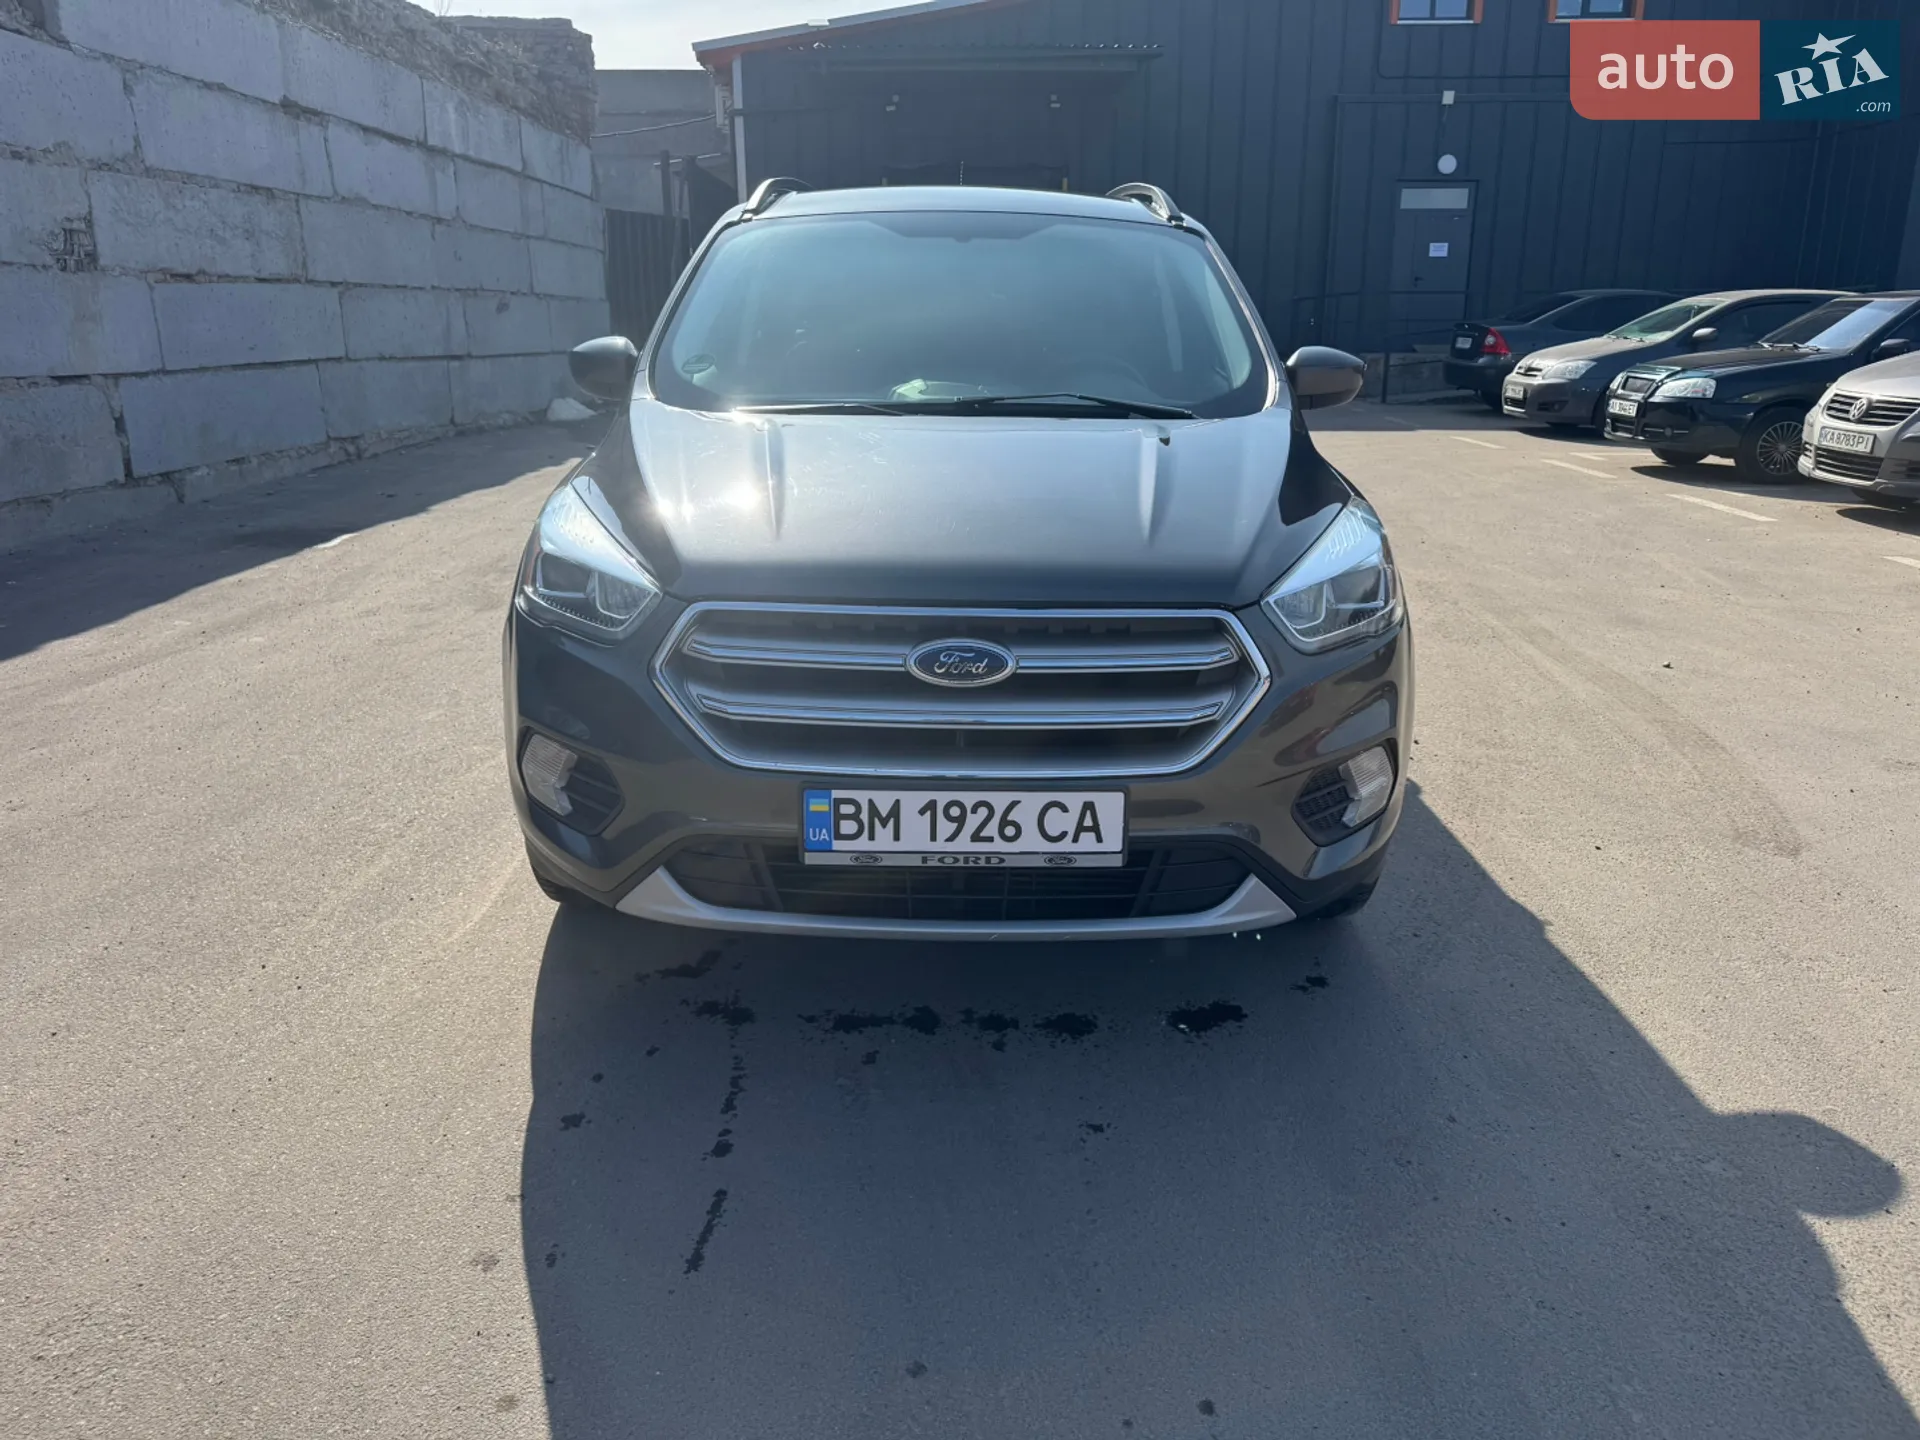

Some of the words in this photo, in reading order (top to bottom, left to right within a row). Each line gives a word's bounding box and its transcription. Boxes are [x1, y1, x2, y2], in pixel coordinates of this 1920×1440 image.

[933, 650, 989, 675] Ford
[833, 797, 901, 842] BM
[917, 798, 1023, 844] 1926
[1037, 800, 1104, 844] CA
[809, 828, 830, 841] UA
[921, 855, 1006, 865] FORD
